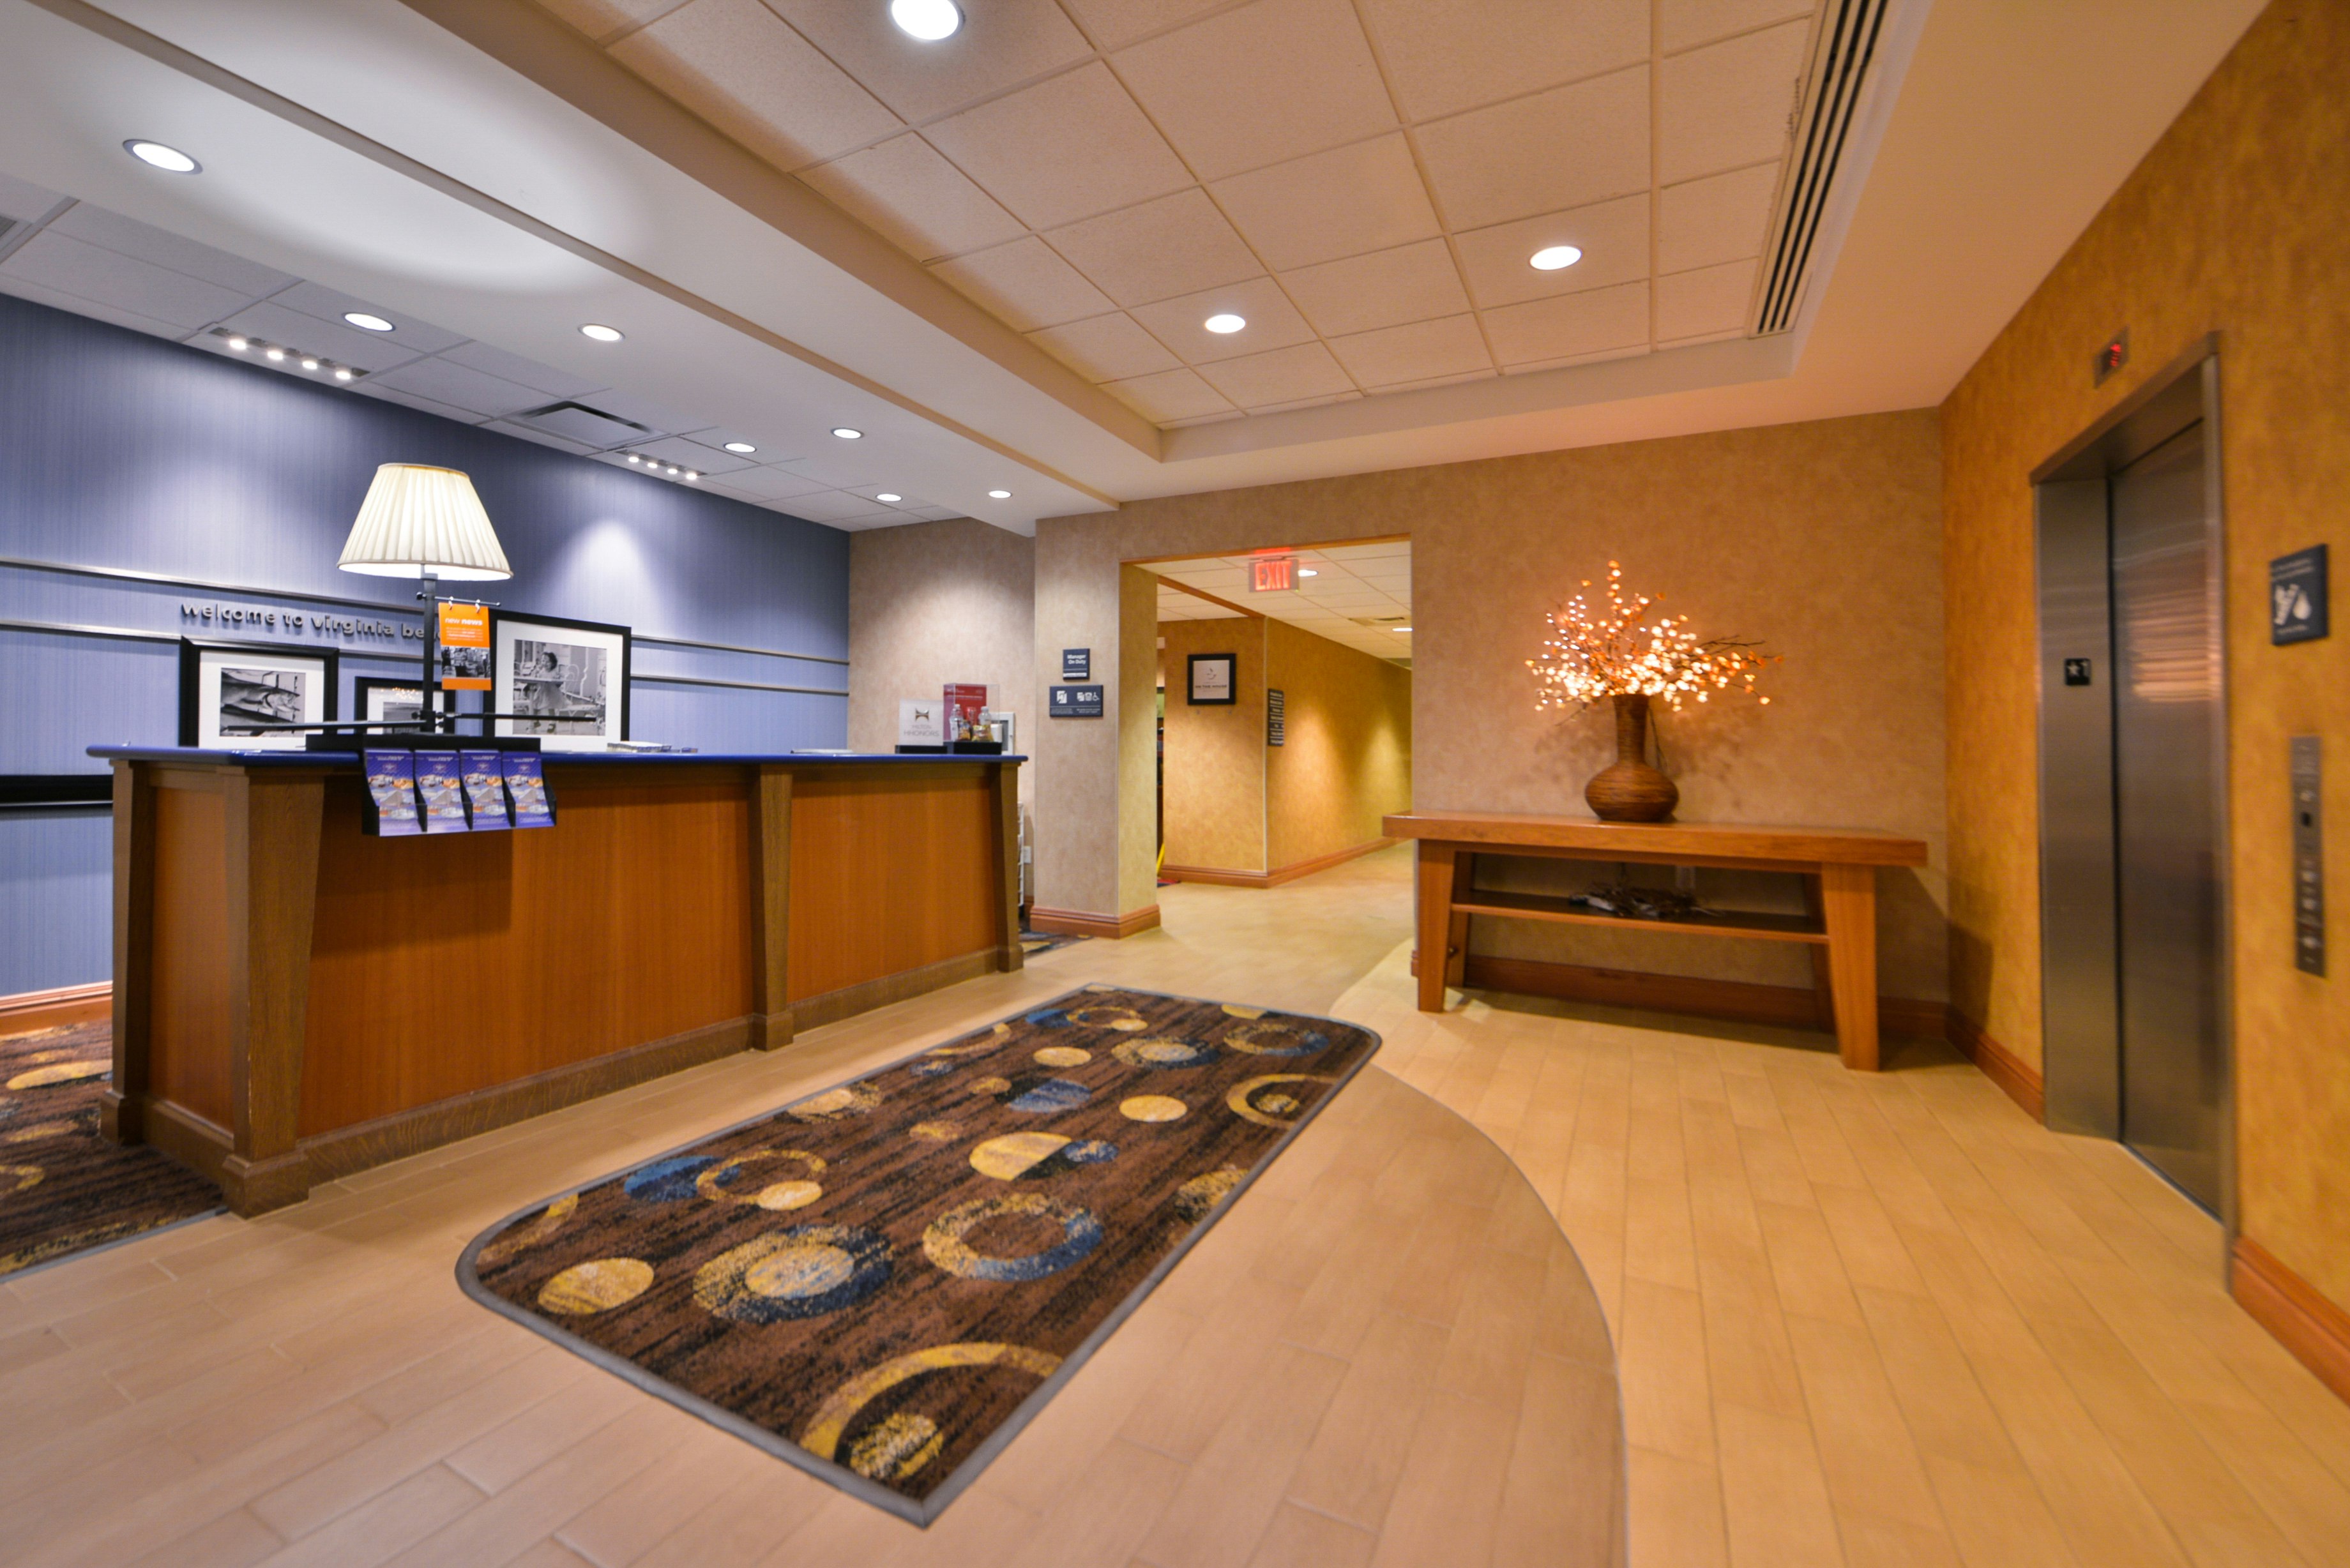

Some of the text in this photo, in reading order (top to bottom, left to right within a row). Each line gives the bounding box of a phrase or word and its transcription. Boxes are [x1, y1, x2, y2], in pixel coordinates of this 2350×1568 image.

[1254, 560, 1292, 591] EXIT
[181, 603, 276, 625] welcome
[283, 612, 303, 628] to
[311, 615, 394, 636] virginia
